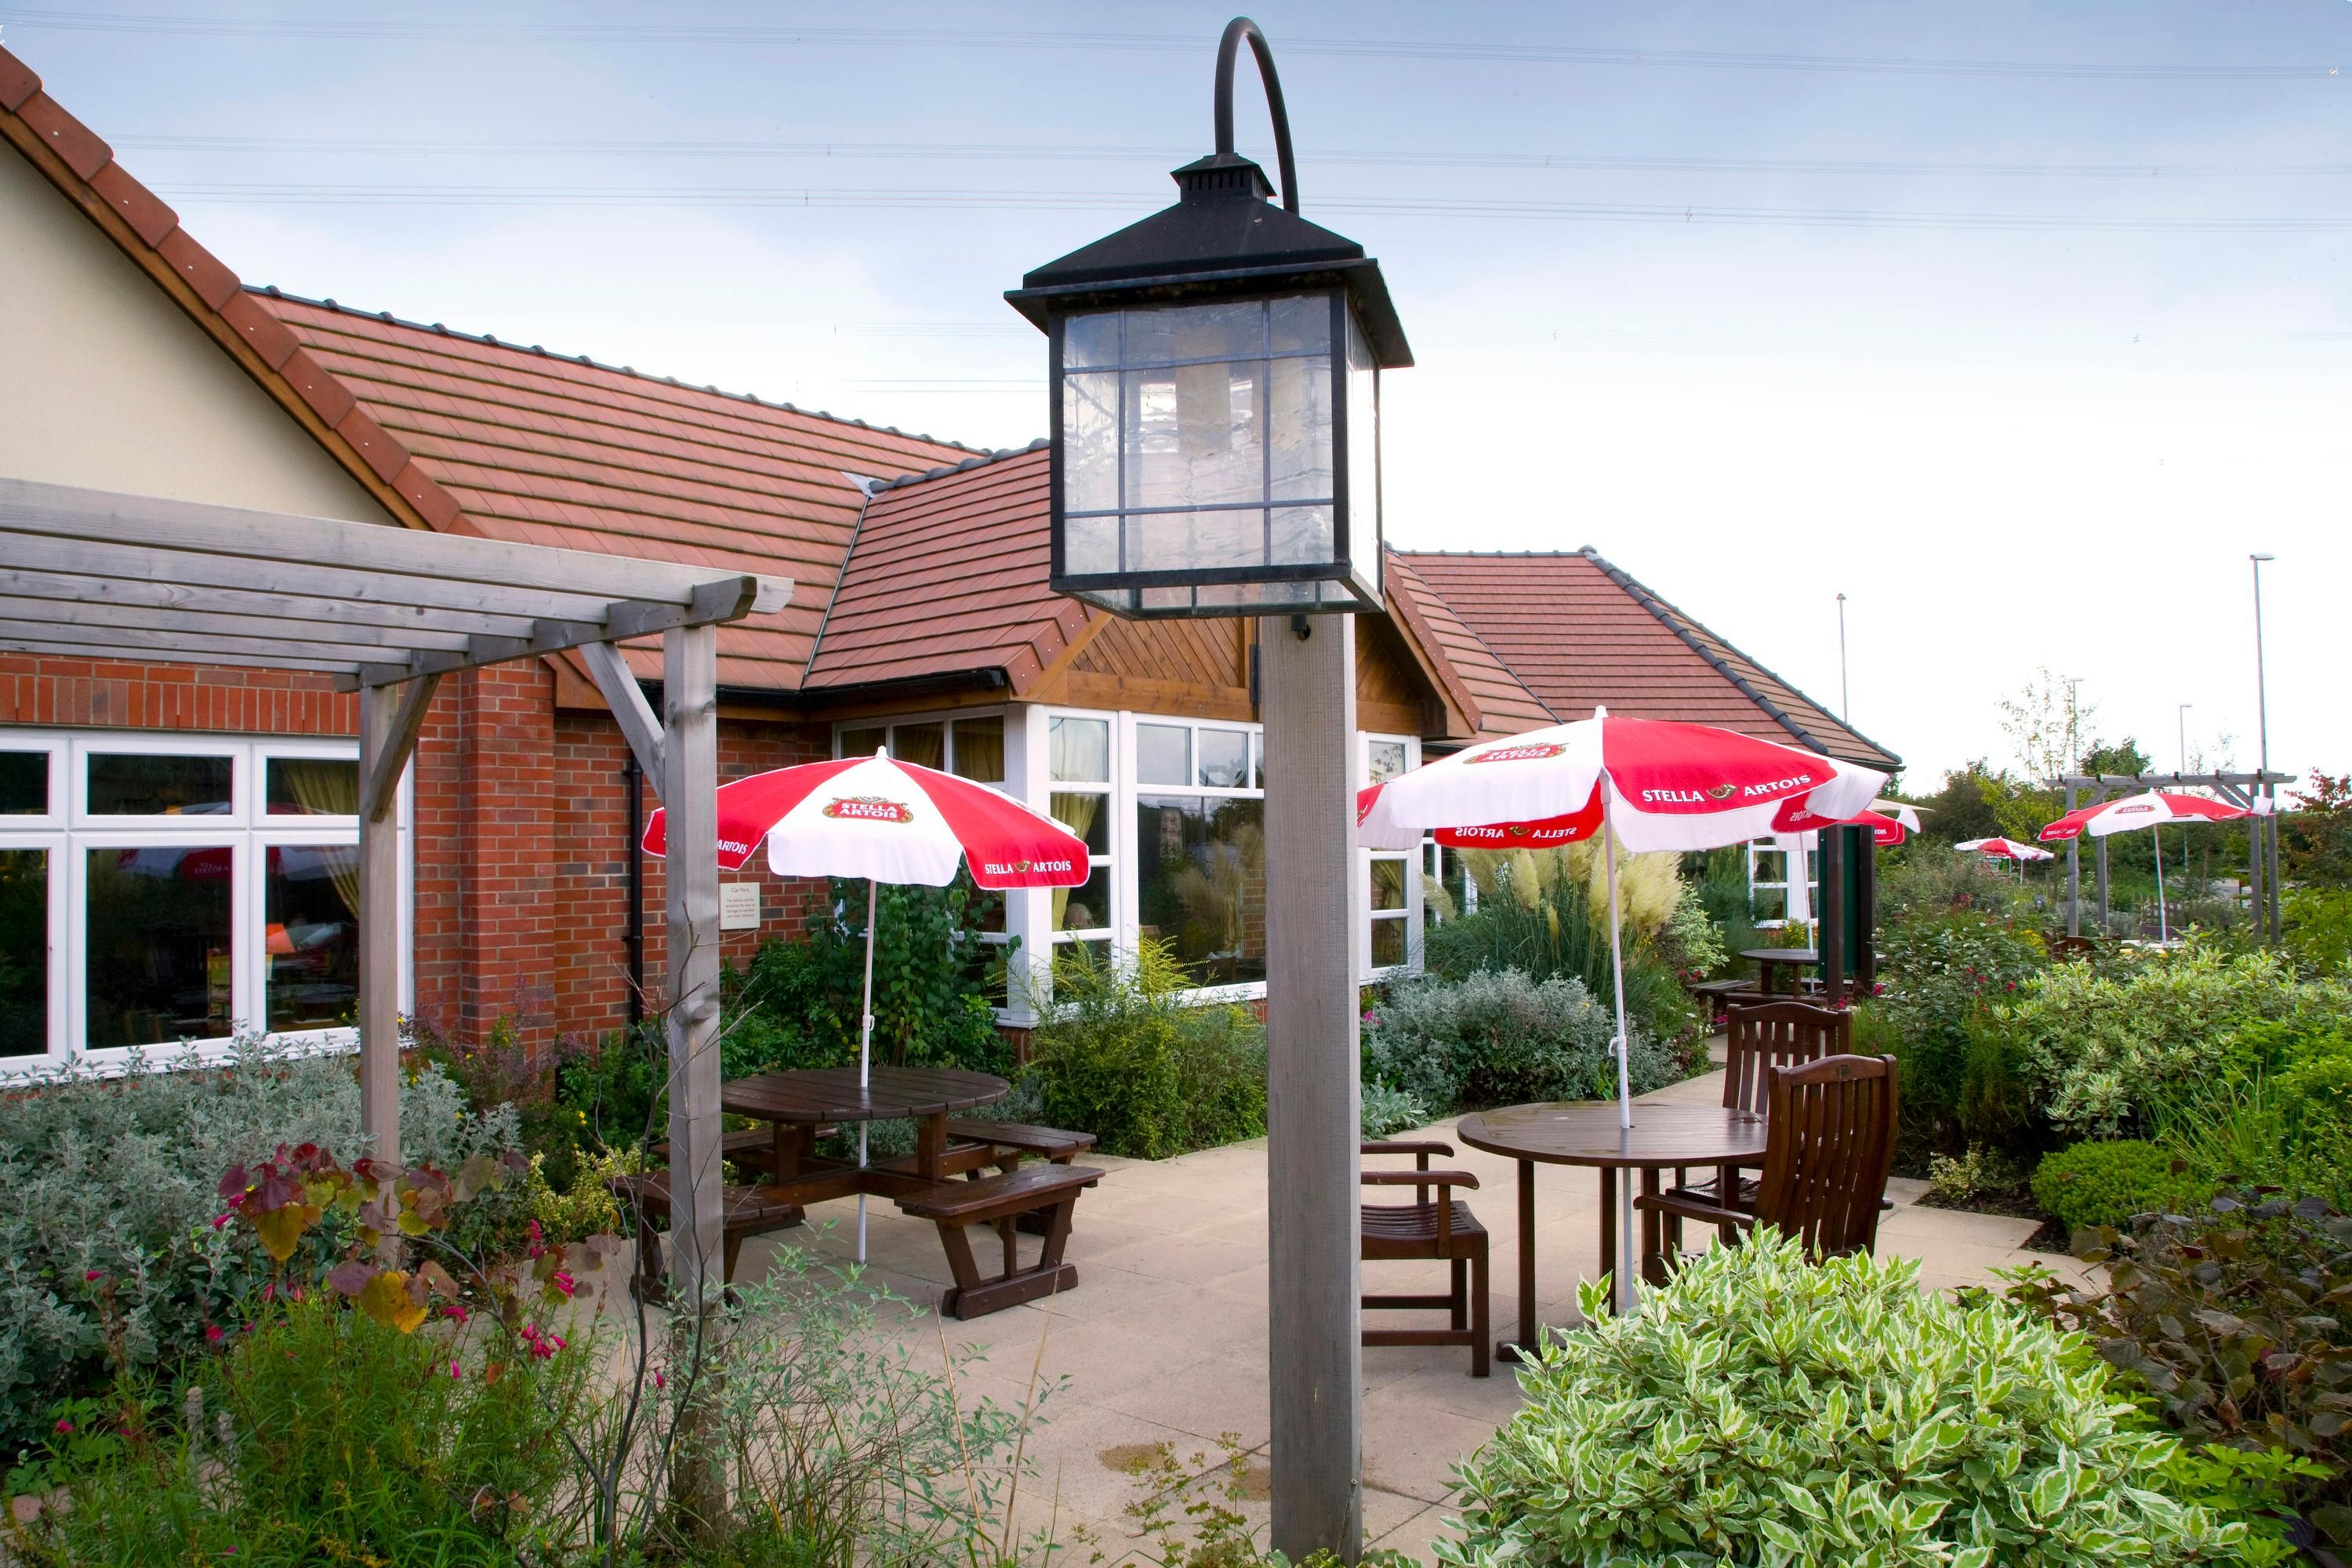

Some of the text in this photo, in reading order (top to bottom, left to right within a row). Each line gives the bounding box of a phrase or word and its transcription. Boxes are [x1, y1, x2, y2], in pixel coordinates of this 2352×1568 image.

[1642, 775, 1813, 803] STELLA ARTOIS
[839, 808, 898, 818] ARTOIS
[840, 802, 898, 813] STELLA
[716, 839, 748, 855] ARTOIS
[985, 860, 1072, 874] STELLA ARTOIS
